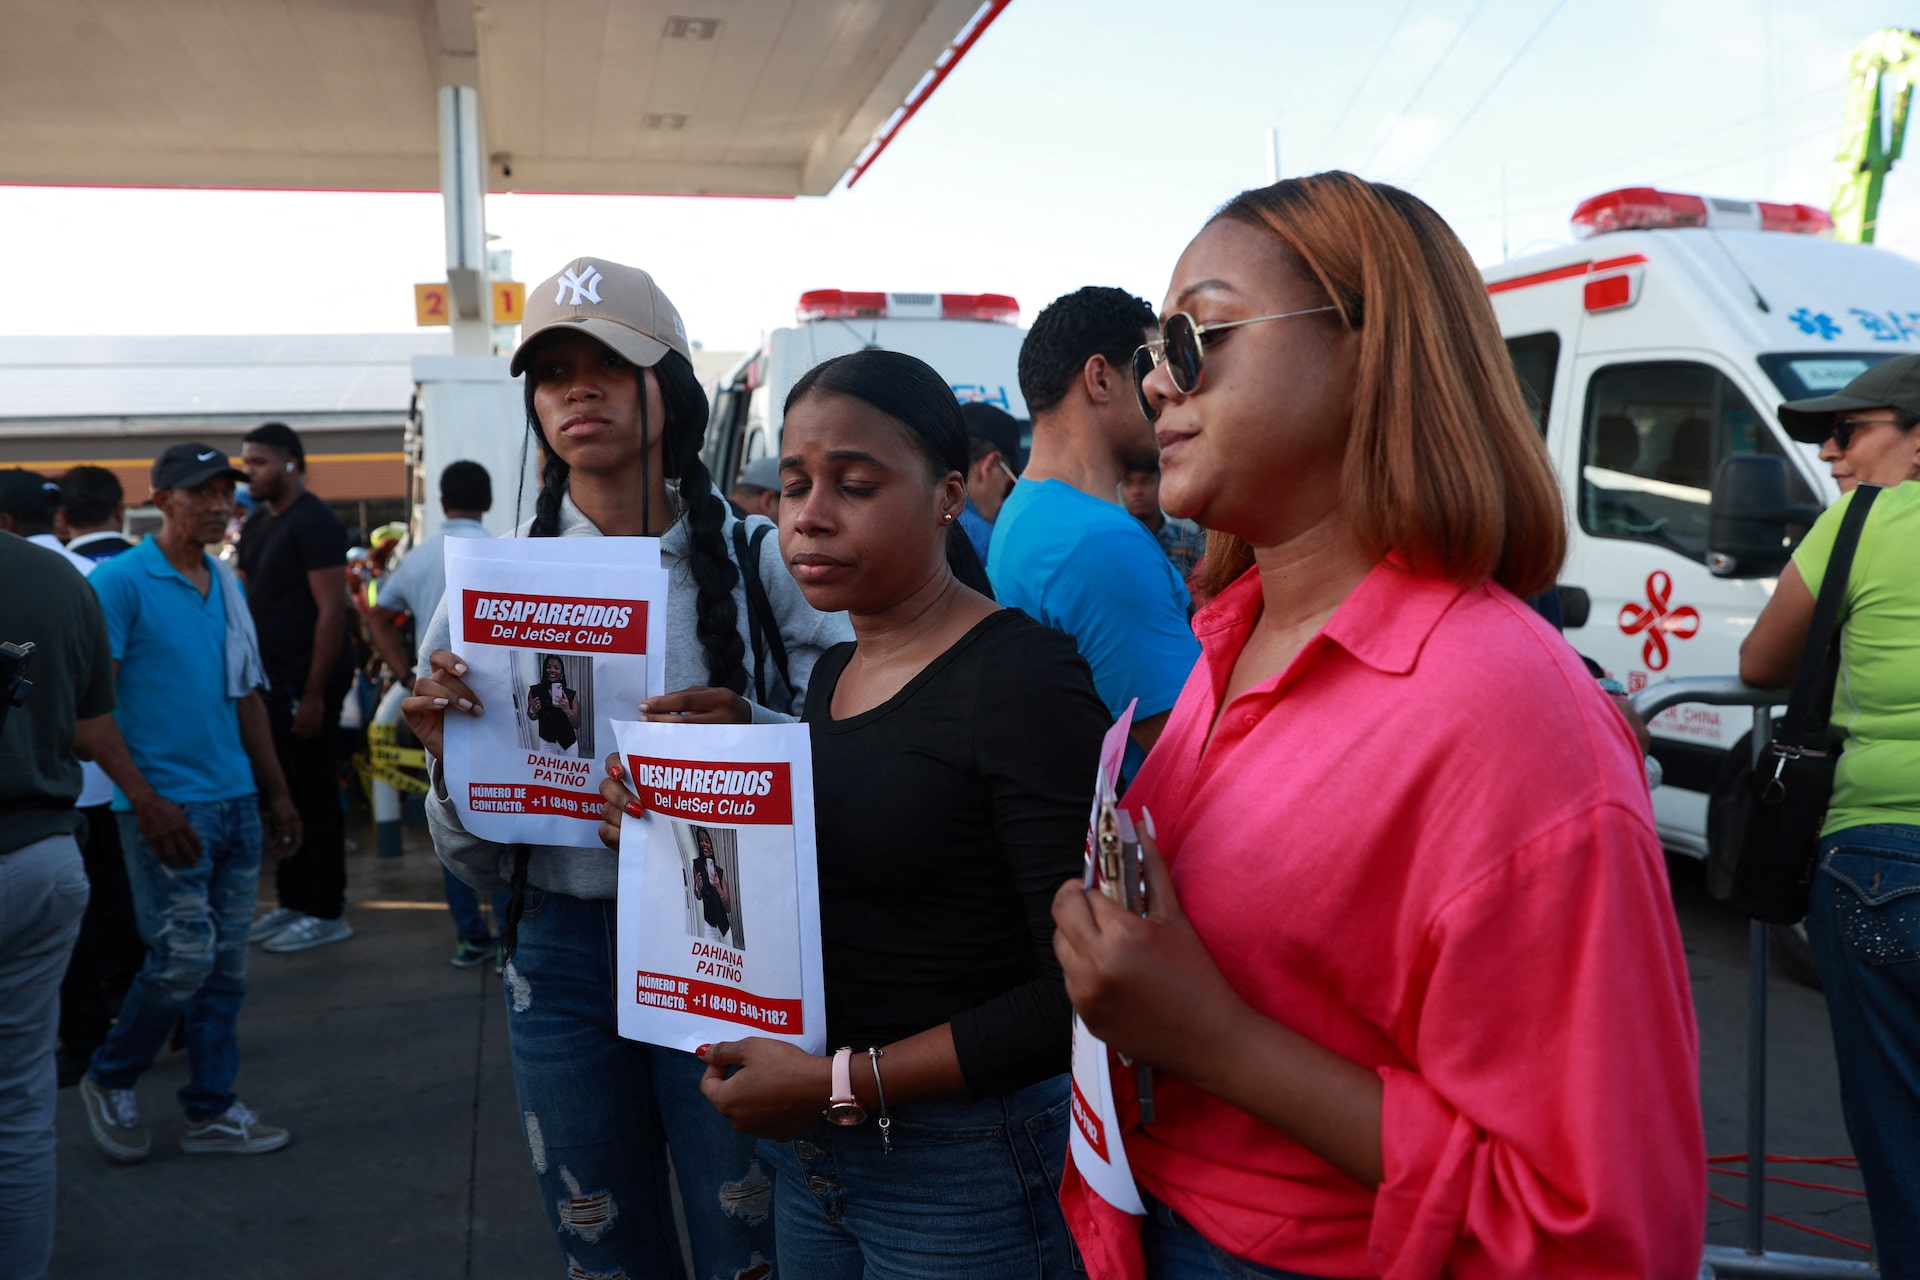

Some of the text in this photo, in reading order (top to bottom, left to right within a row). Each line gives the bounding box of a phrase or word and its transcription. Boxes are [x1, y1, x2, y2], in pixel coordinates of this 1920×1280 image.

[424, 291, 443, 316] 2
[501, 291, 512, 314] 1
[474, 598, 632, 629] DESAPARECIDOS
[491, 624, 613, 646] Del JetSet Club
[527, 754, 590, 774] DAHIANA
[533, 768, 586, 787] PATIÑO
[639, 763, 773, 796] DESAPARECIDOS
[471, 785, 526, 799] NÚMERO DE
[472, 800, 525, 813] CONTACTO:
[531, 795, 546, 807] +1
[550, 797, 578, 812] (849)
[654, 792, 756, 816] Del JetSet Club
[691, 942, 744, 968] DAHIANA
[696, 960, 742, 983] PATIÑO
[638, 974, 689, 995] NÚMERO DE
[638, 991, 788, 1026] CONTACTO: +1 (849) 540-7182
